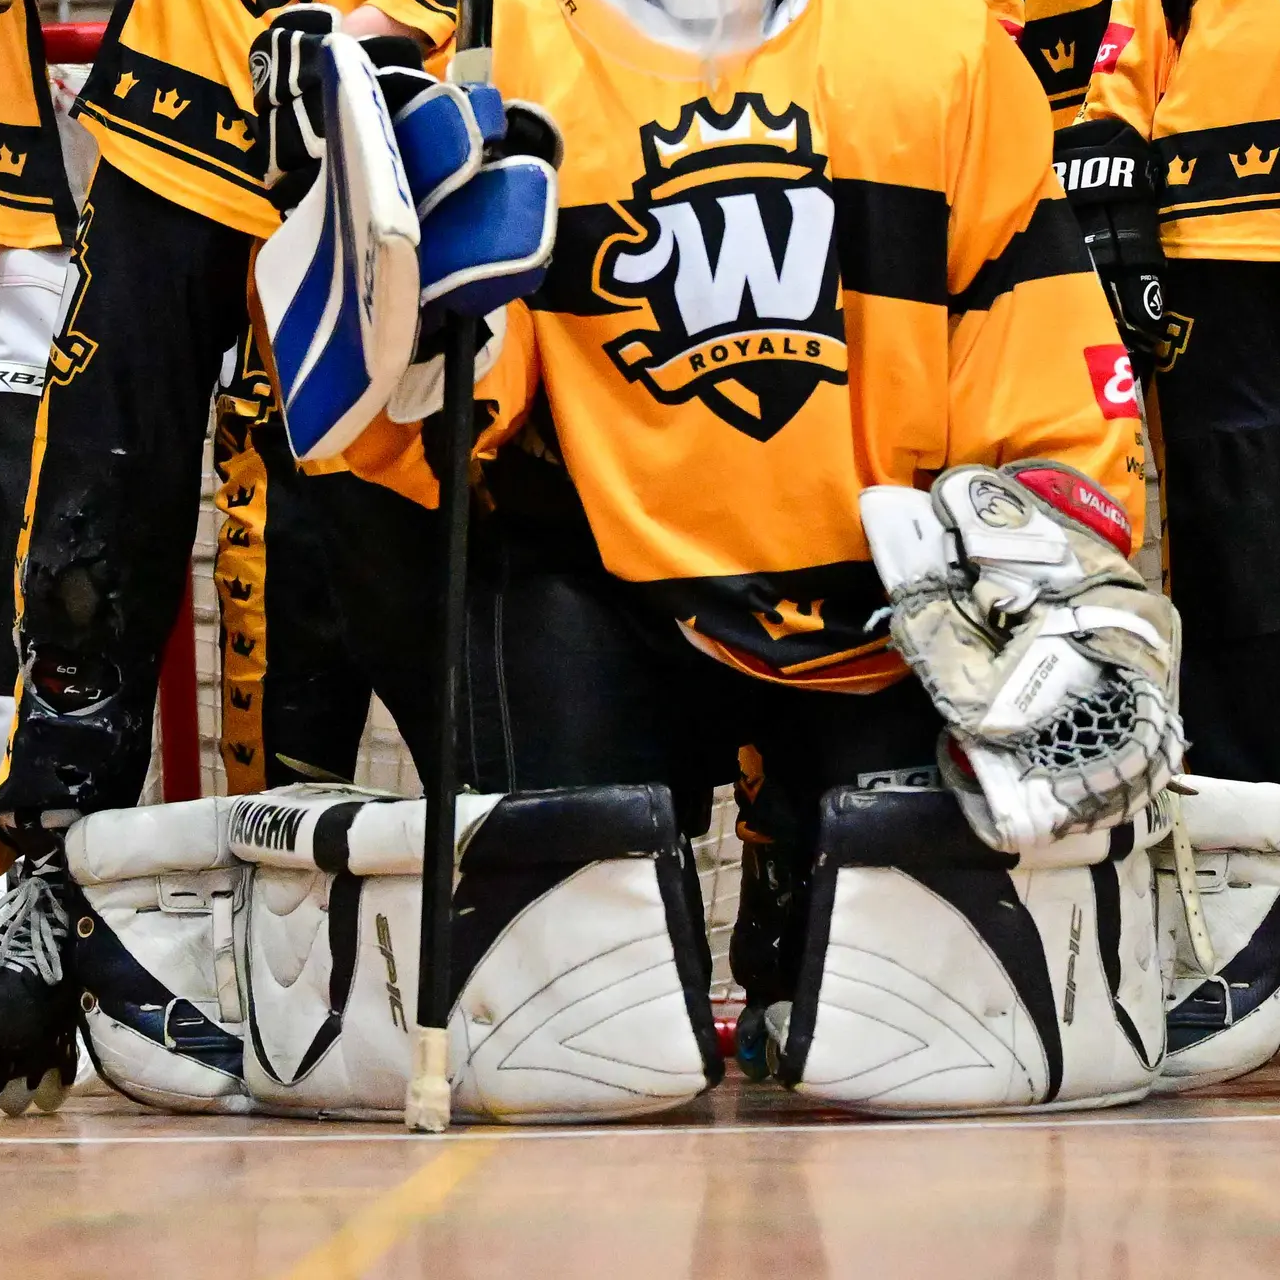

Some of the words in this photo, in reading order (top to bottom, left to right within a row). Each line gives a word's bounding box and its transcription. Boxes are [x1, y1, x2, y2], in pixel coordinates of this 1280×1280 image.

[612, 186, 836, 338] W
[688, 336, 822, 373] ROYALS
[1078, 486, 1133, 537] VAUGH
